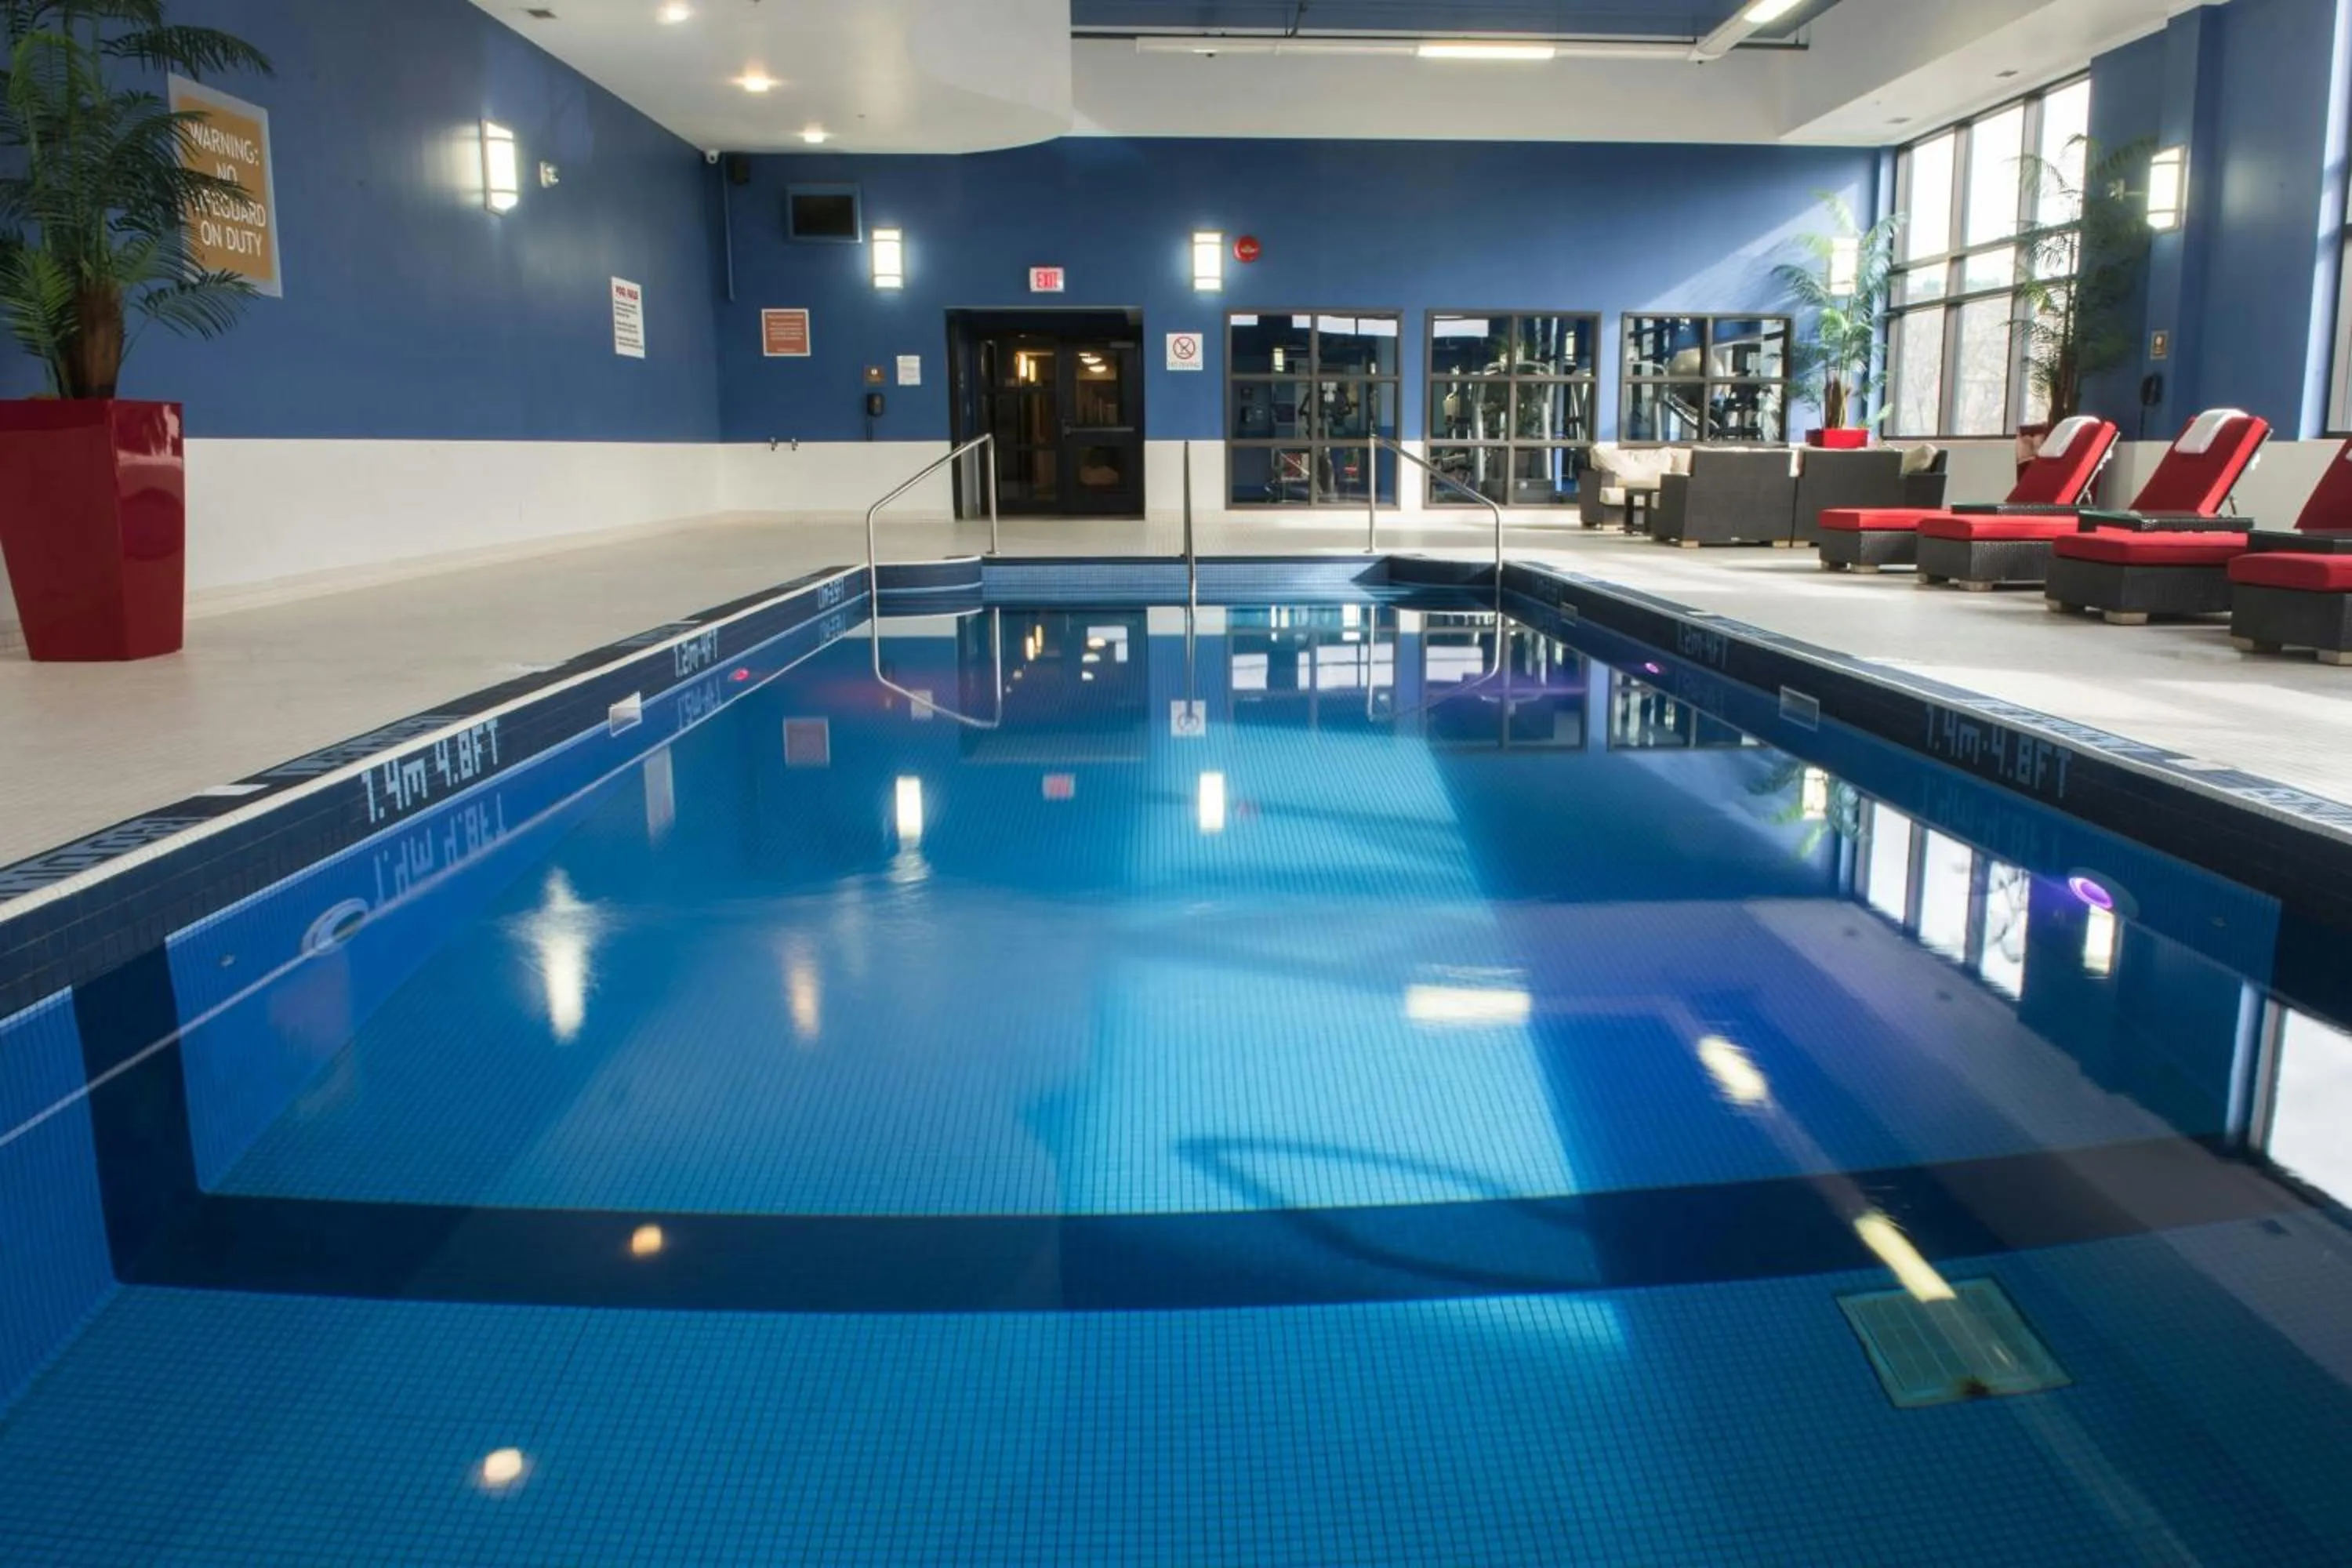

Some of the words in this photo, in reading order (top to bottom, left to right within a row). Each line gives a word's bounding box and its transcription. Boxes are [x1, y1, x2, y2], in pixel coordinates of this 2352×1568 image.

[187, 122, 260, 166] WARNING:
[216, 162, 238, 185] NO
[201, 220, 223, 248] ON
[225, 226, 262, 256] DUTY
[1036, 270, 1060, 289] EXIT
[361, 757, 428, 823] 1.4m
[435, 719, 499, 787] 4.8FT
